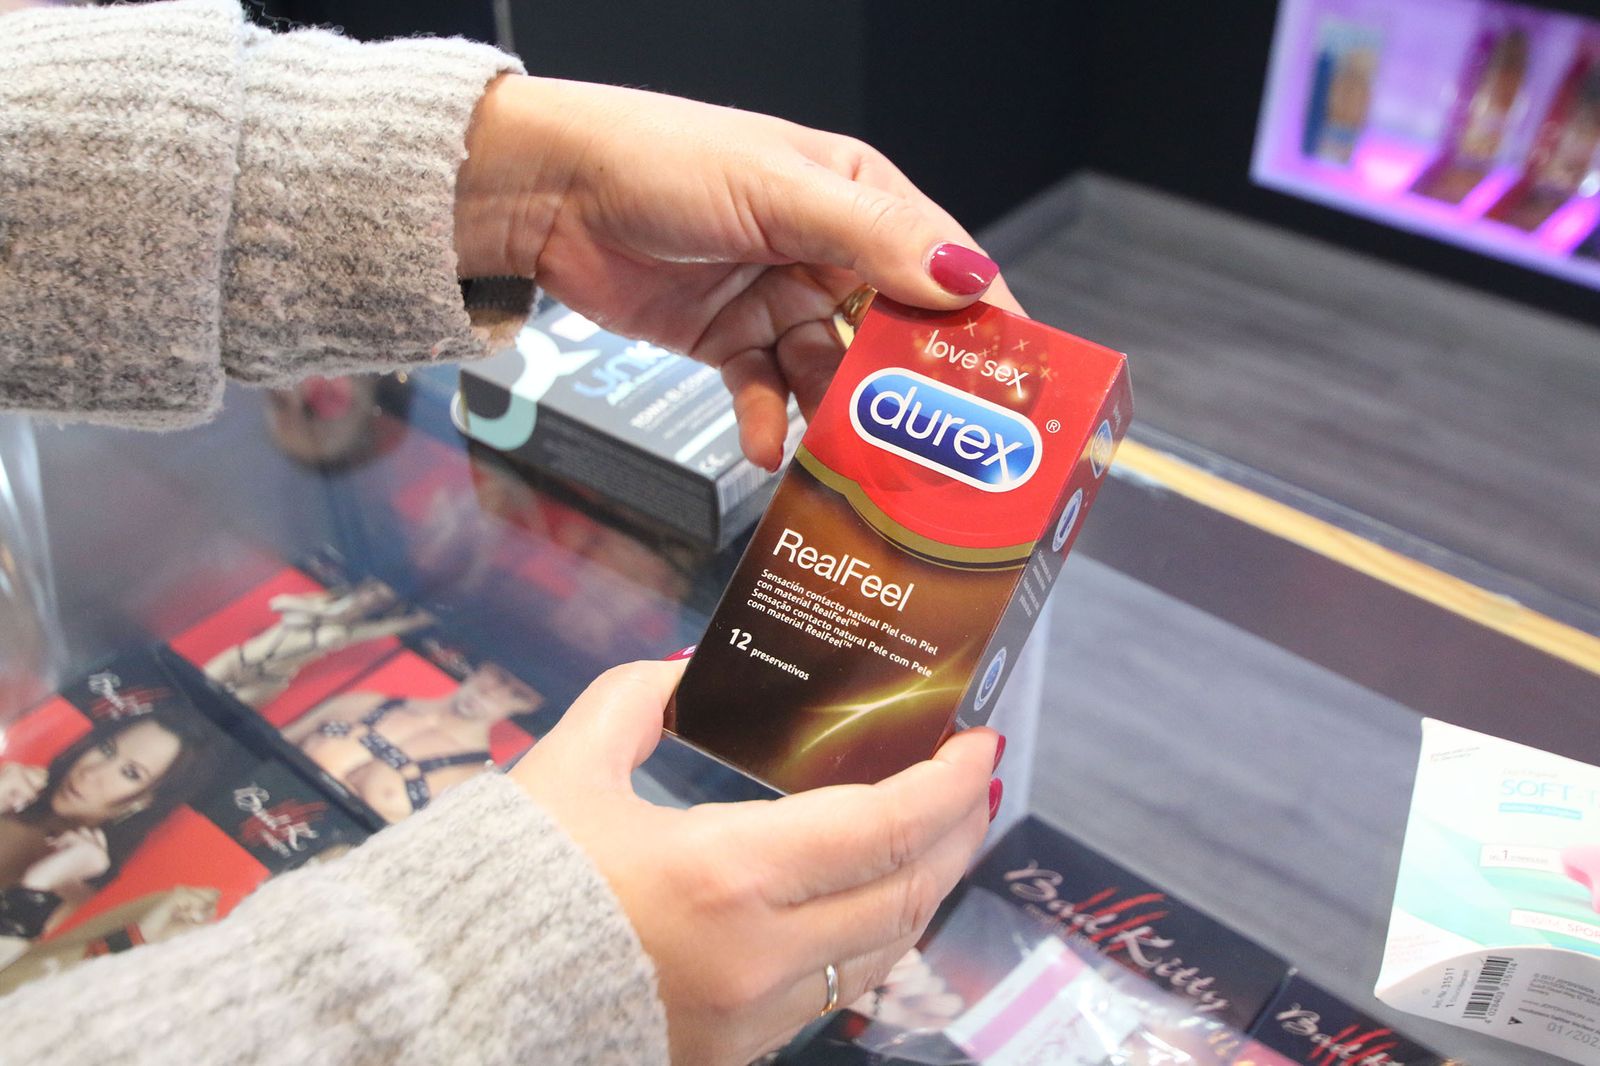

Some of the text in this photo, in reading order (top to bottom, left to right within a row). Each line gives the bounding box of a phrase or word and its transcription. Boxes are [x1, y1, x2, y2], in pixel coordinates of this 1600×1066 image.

[924, 329, 1029, 398] love sex
[869, 387, 1024, 484] durex
[756, 579, 774, 592] con
[774, 586, 811, 609] material
[761, 569, 938, 655] Sensación contacto natural Piel con Piel
[773, 528, 914, 612] RealFeel
[729, 628, 810, 681] 12 preservativos
[747, 599, 766, 612] com
[767, 607, 804, 630] material
[751, 588, 933, 678] Sensação contacto natural Pele com Pele
[1109, 925, 1232, 1013] Kitty
